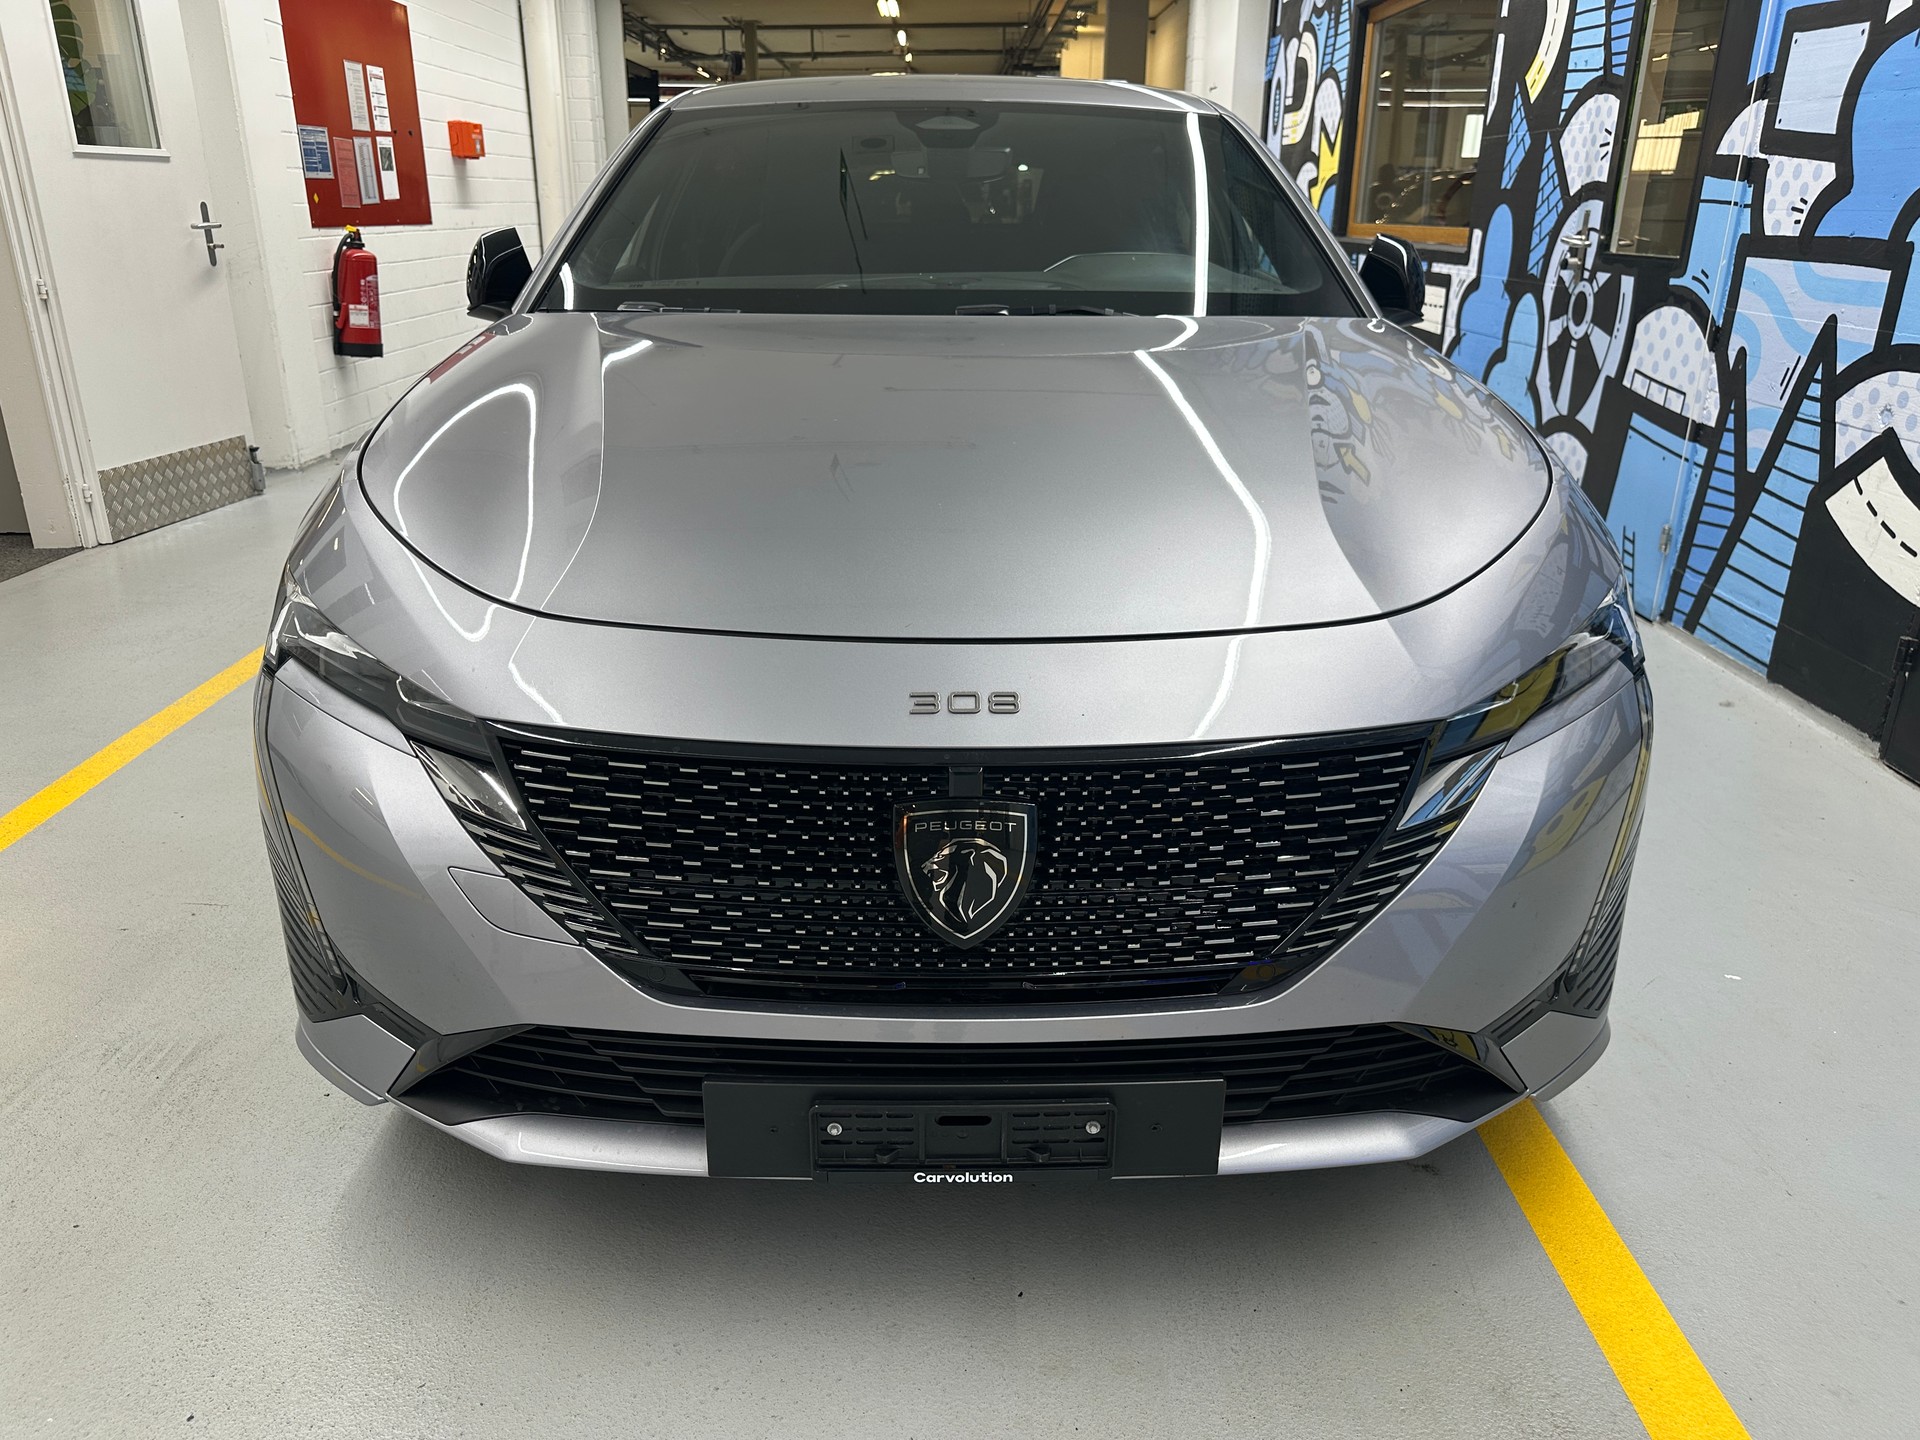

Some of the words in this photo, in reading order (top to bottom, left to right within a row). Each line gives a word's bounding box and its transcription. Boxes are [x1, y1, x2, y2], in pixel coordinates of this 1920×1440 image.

[909, 692, 1020, 714] 308
[914, 821, 1016, 832] PEUGEOT
[913, 1172, 1013, 1182] Carvolution
